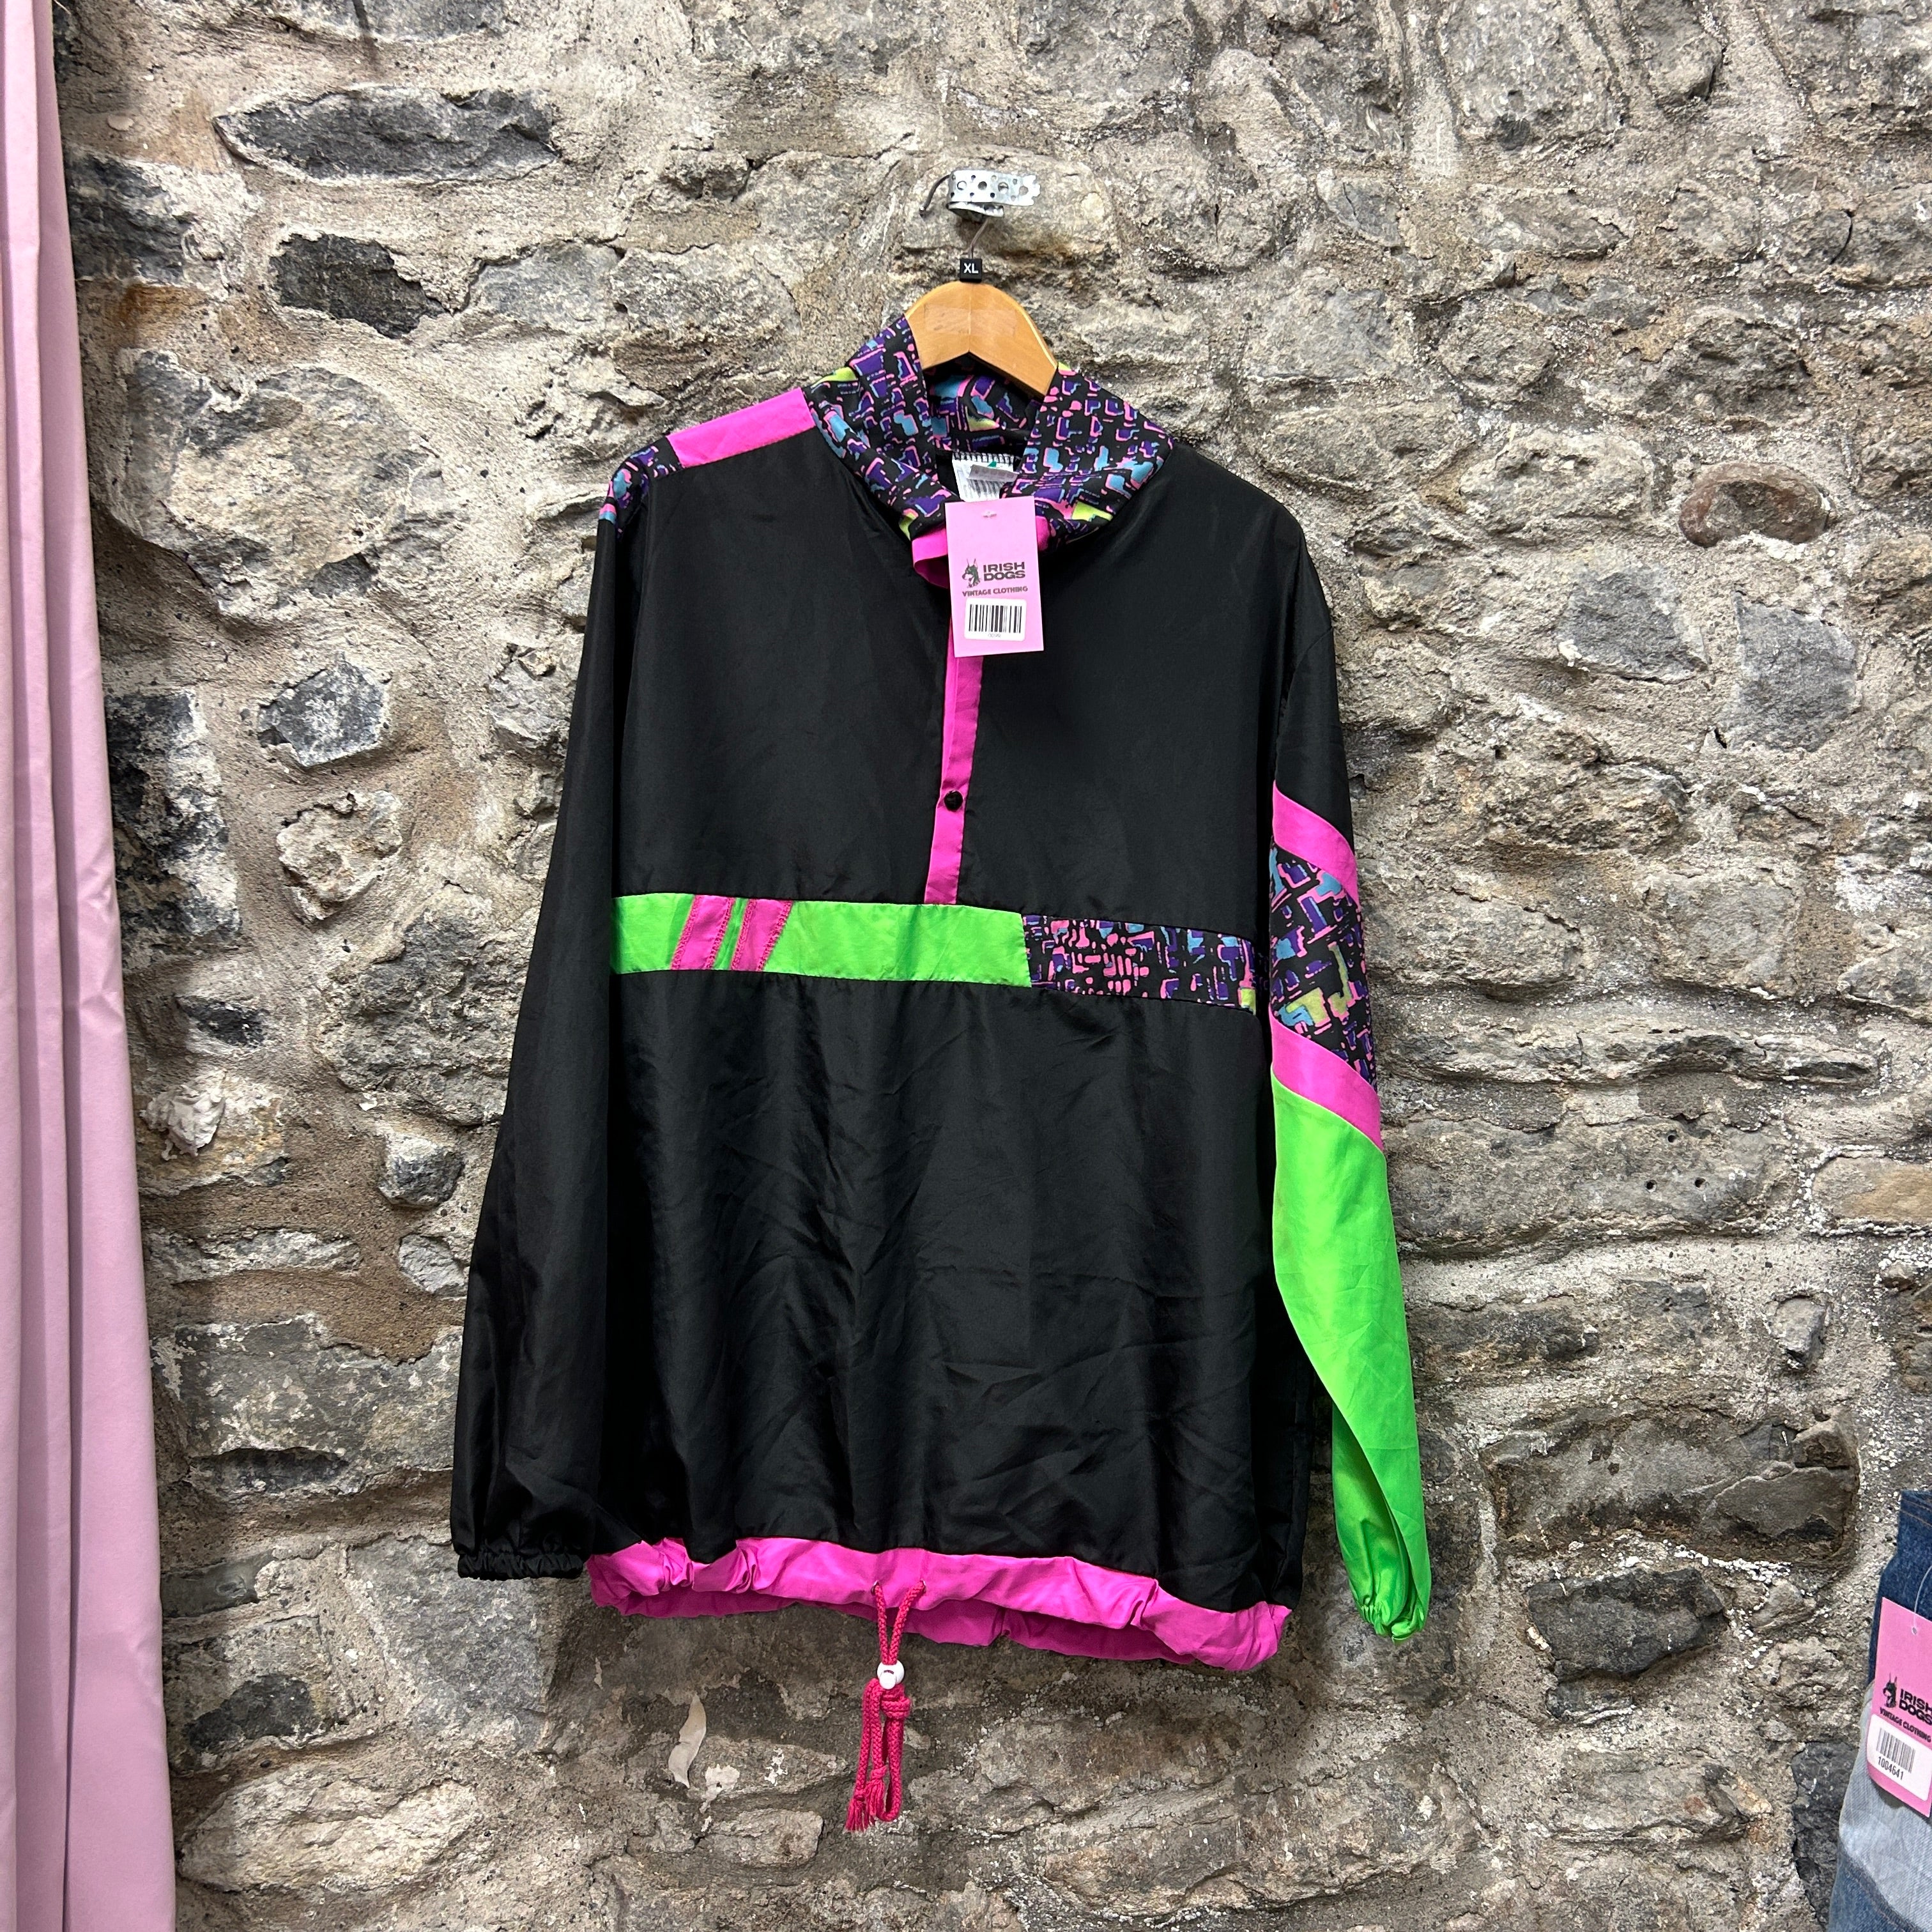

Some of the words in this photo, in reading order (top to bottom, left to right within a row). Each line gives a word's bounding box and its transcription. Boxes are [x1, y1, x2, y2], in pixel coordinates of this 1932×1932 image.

[963, 263, 979, 273] XL
[983, 562, 1025, 573] IRISH
[984, 571, 1025, 581] DOGS
[962, 588, 992, 597] VINTAGE
[993, 586, 1028, 594] CLOTHING
[1899, 1688, 1932, 1715] IRISH
[1899, 1698, 1932, 1726] DOGS
[1880, 1706, 1903, 1726] VINTAGE
[1903, 1721, 1931, 1743] CLOTHING
[1878, 1756, 1904, 1781] 1004641
